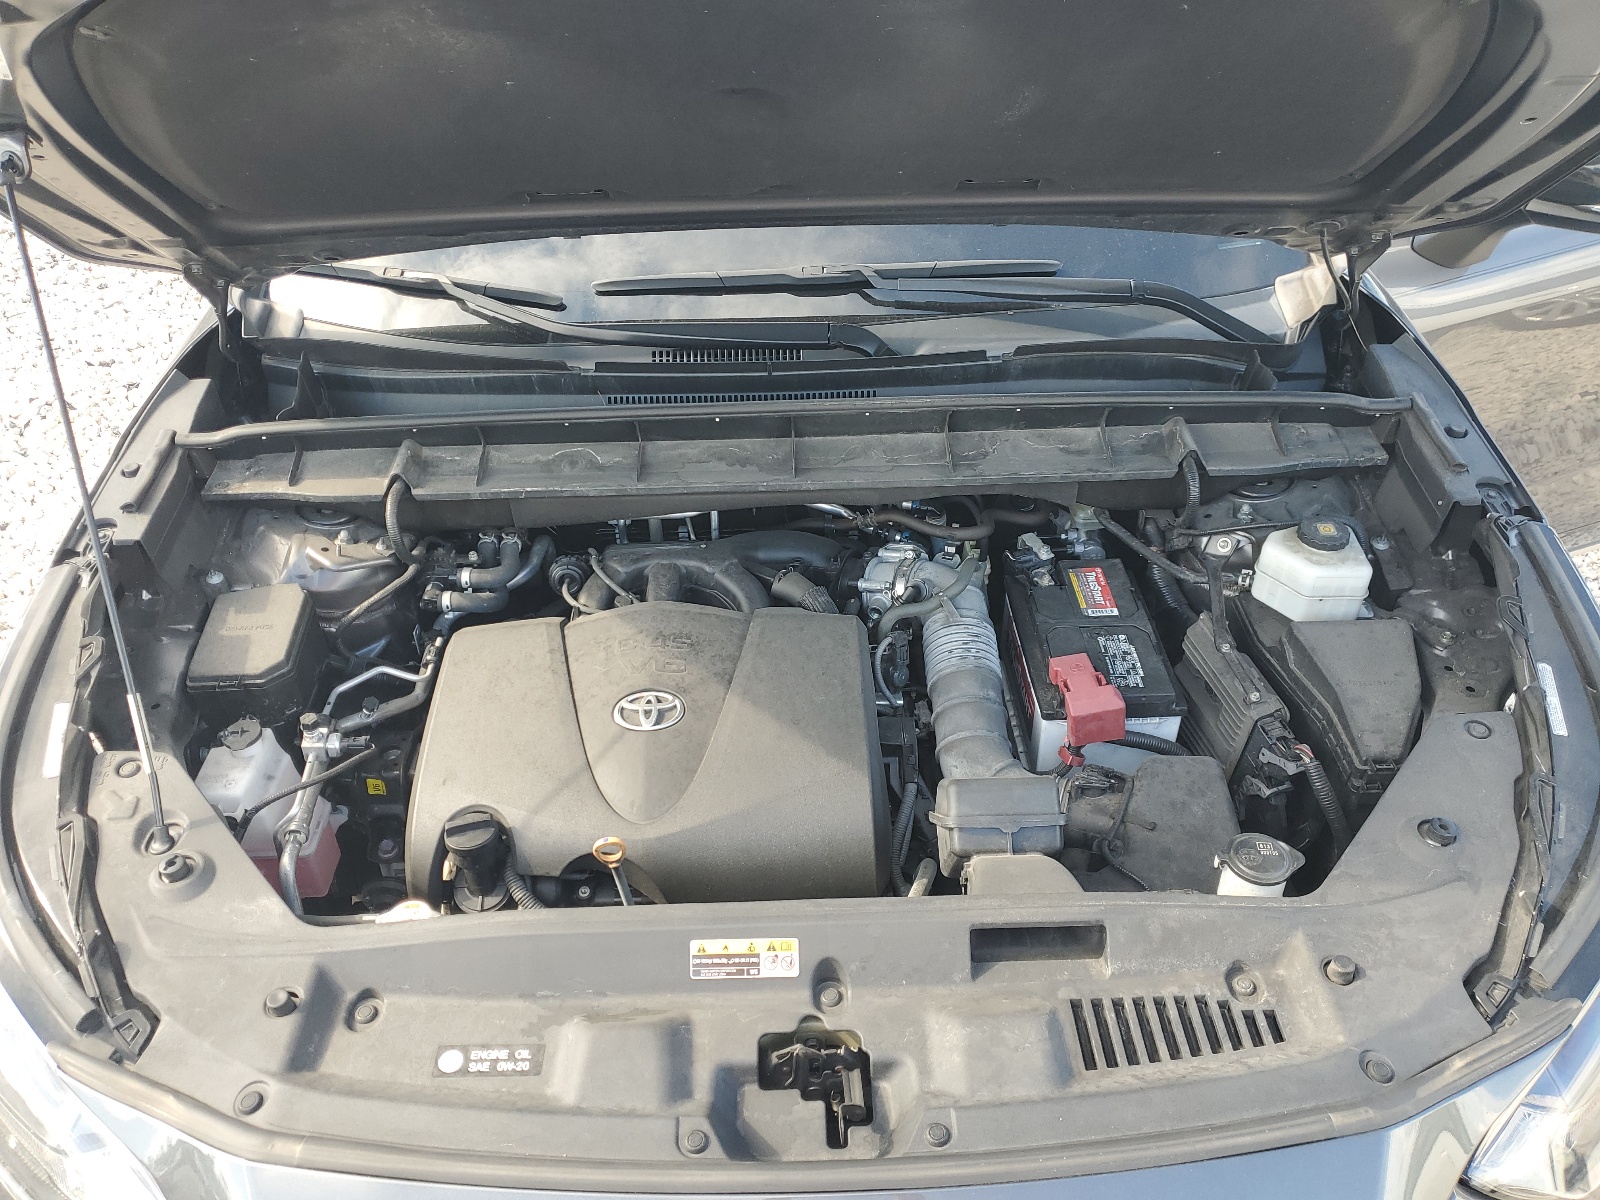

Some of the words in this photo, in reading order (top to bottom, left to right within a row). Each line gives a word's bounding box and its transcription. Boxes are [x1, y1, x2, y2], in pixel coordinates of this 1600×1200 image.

[618, 656, 688, 675] V6
[470, 1049, 510, 1060] ENGINE
[514, 1049, 532, 1059] OIL
[468, 1062, 491, 1072] SAE
[496, 1061, 530, 1072] 0W-20
